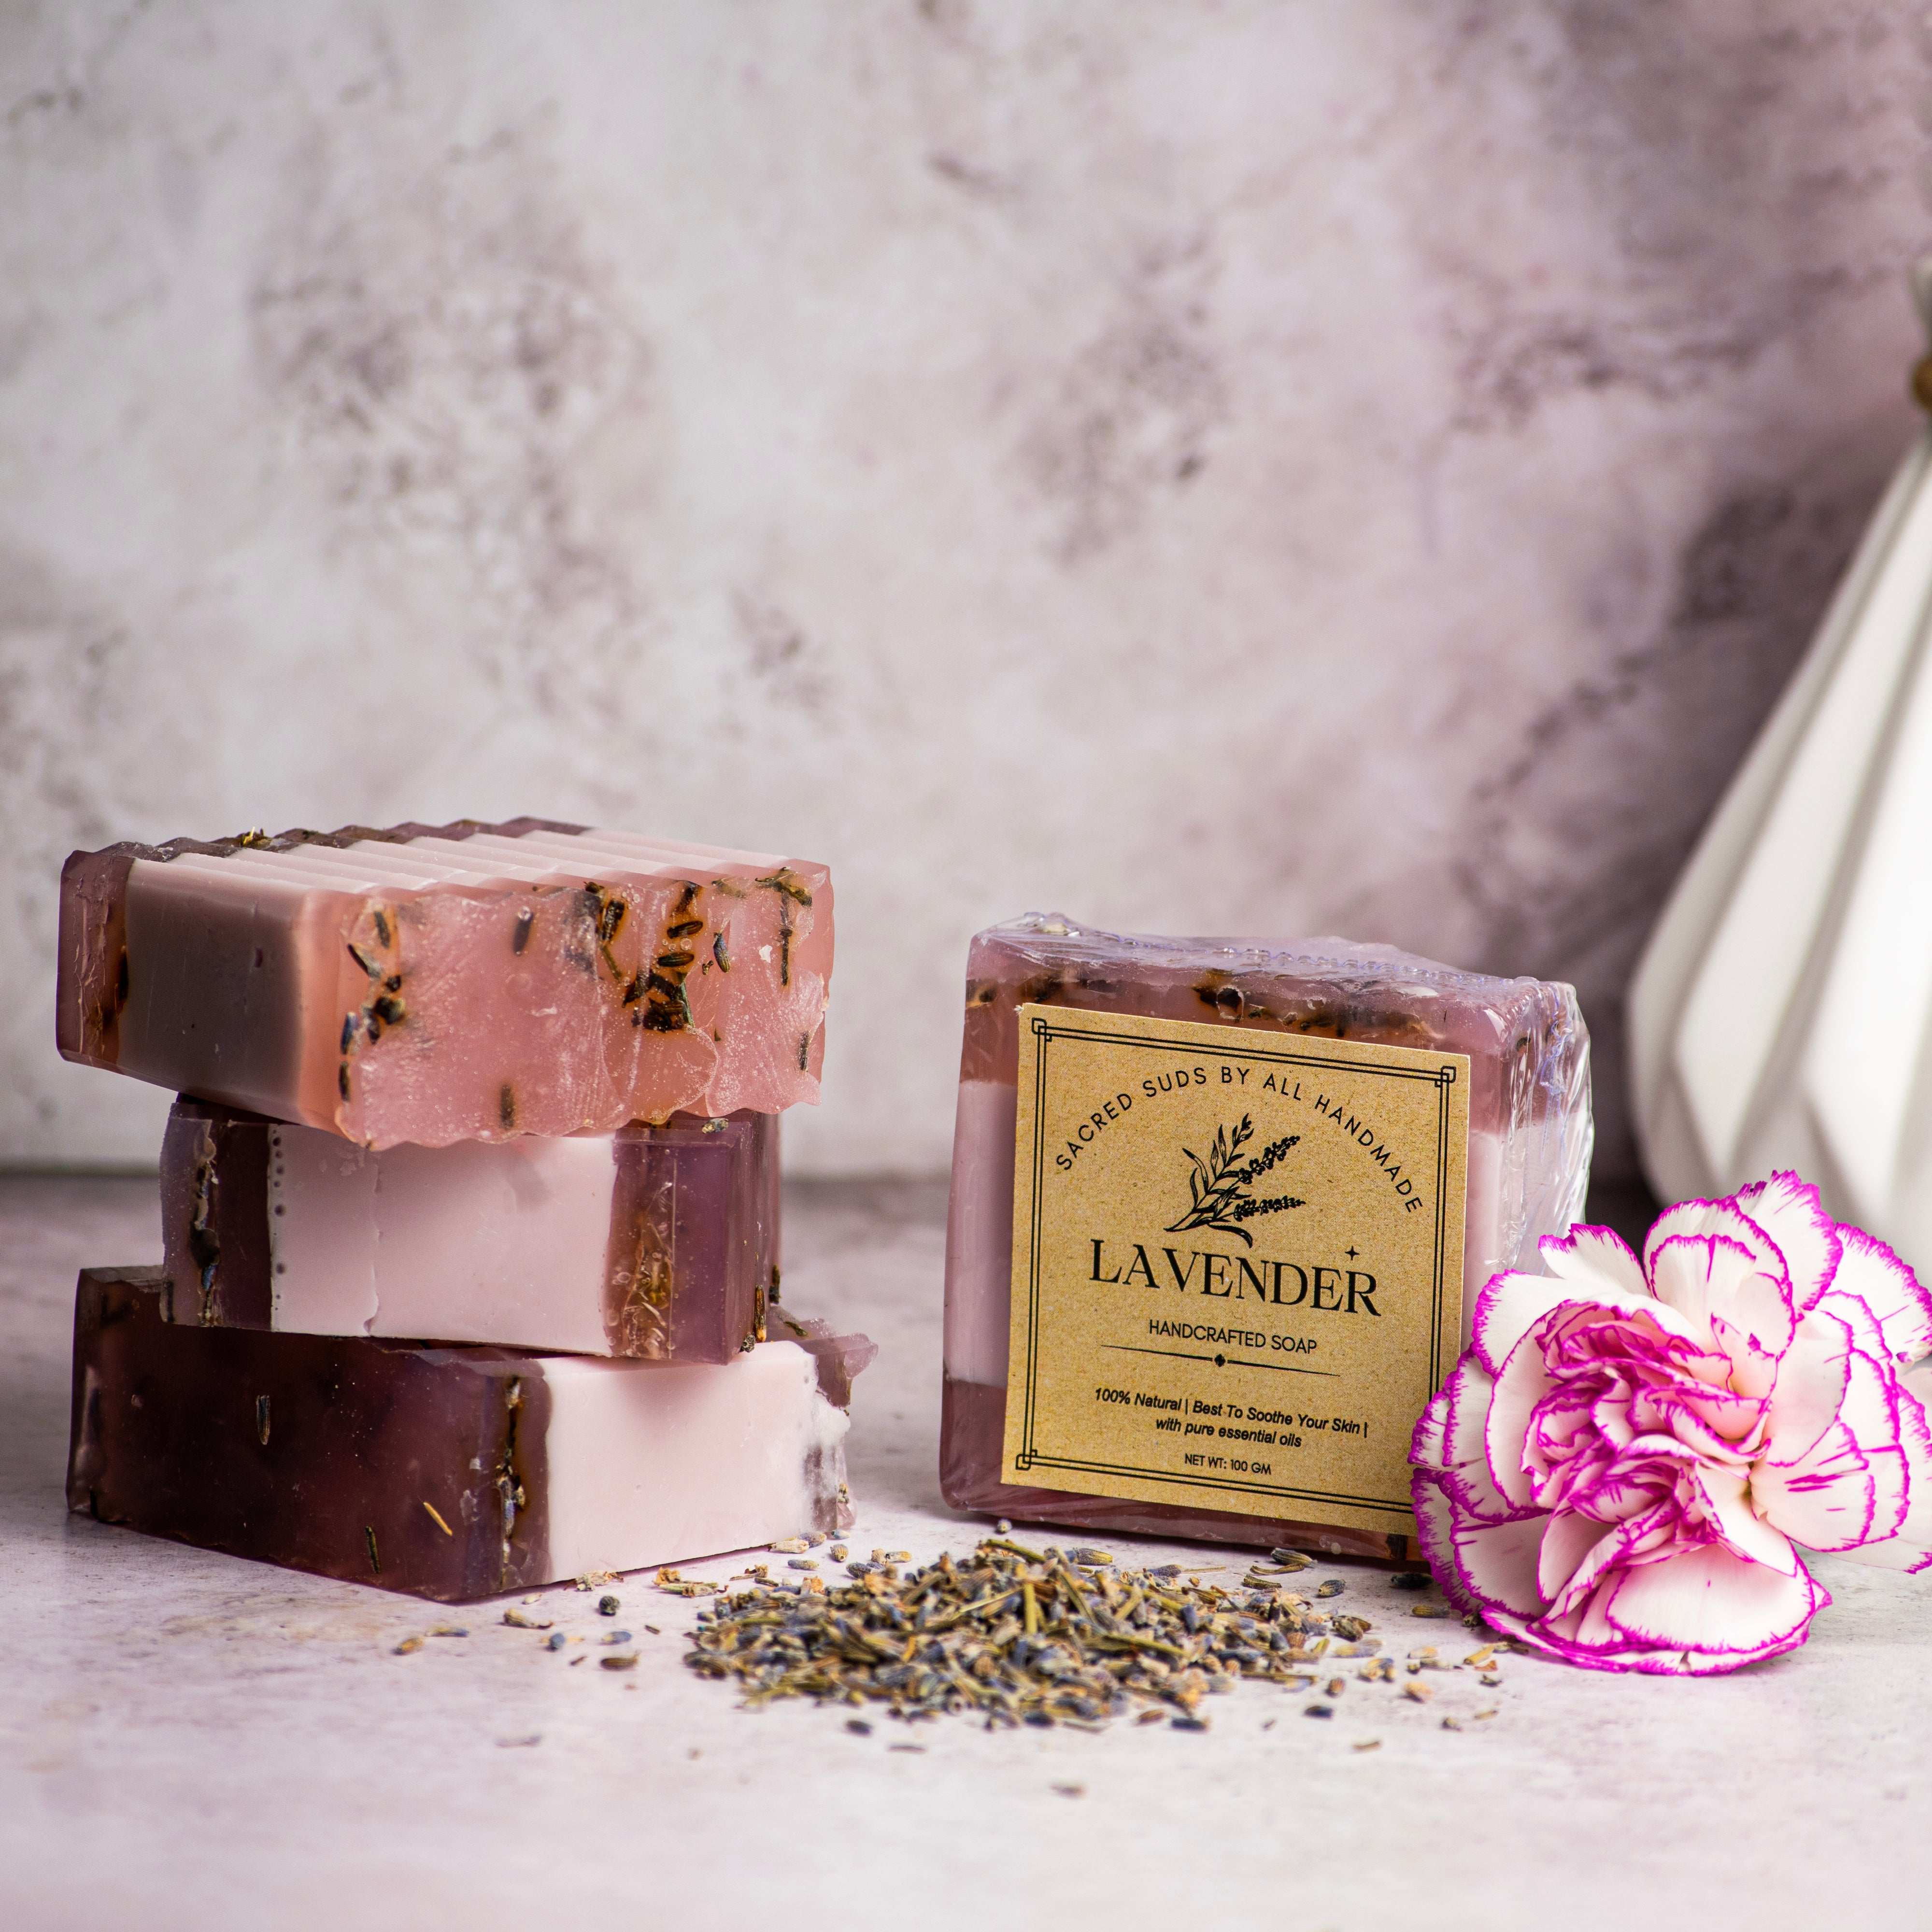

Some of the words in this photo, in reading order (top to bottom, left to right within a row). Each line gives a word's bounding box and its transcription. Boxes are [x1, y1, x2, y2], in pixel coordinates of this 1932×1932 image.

[1056, 1094, 1132, 1170] SACRED
[1142, 1067, 1207, 1097] SUDS
[1221, 1066, 1250, 1085] BY
[1263, 1073, 1301, 1101] ALL
[1314, 1094, 1423, 1213] HANDMADE
[1089, 1239, 1381, 1317] LAVENDER
[1149, 1319, 1266, 1348] HANDCRAFTED
[1271, 1335, 1317, 1354] SOAP
[1095, 1388, 1131, 1405] 100%
[1134, 1392, 1182, 1411] Natural
[1193, 1400, 1223, 1416] Best
[1226, 1404, 1243, 1419] To
[1247, 1407, 1293, 1425] Soothe
[1298, 1413, 1329, 1430] Your
[1331, 1418, 1361, 1435] Skin
[1156, 1417, 1182, 1432] with
[1184, 1423, 1215, 1436] pure
[1218, 1427, 1277, 1444] essential
[1279, 1433, 1302, 1448] oils
[1184, 1453, 1206, 1466] NET
[1208, 1456, 1227, 1469] WT:
[1230, 1459, 1248, 1472] 100
[1251, 1462, 1271, 1475] GM
